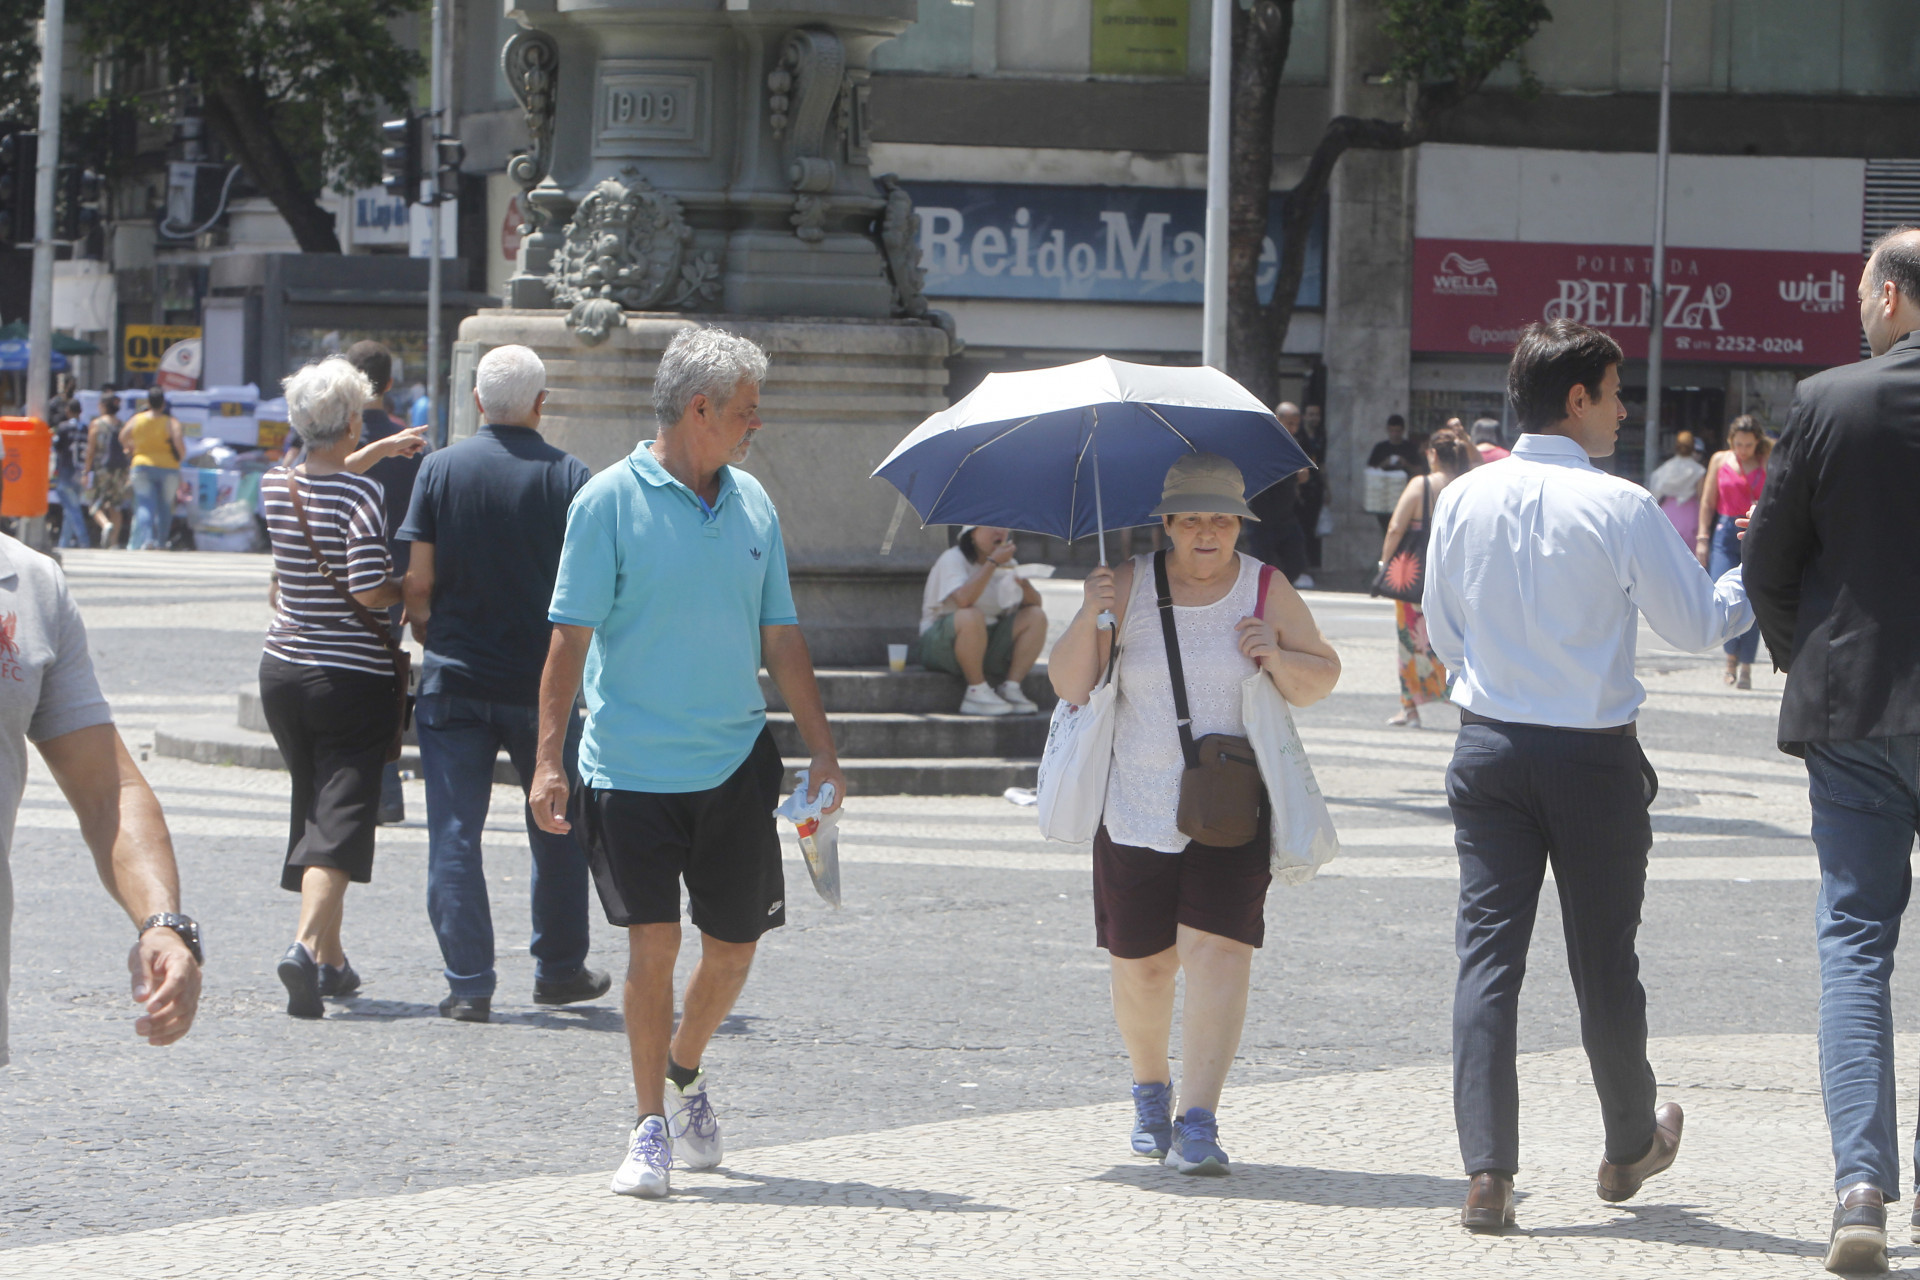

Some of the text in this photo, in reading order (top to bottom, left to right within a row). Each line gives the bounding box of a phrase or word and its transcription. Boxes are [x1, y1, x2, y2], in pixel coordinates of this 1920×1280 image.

[609, 92, 675, 123] 1909
[914, 206, 1278, 286] Rei do Mae
[1577, 255, 1699, 276] POINT DA
[1433, 275, 1497, 290] WELLA
[1779, 270, 1845, 303] widi
[128, 336, 184, 358] OU
[1715, 336, 1804, 353] 2252-0204
